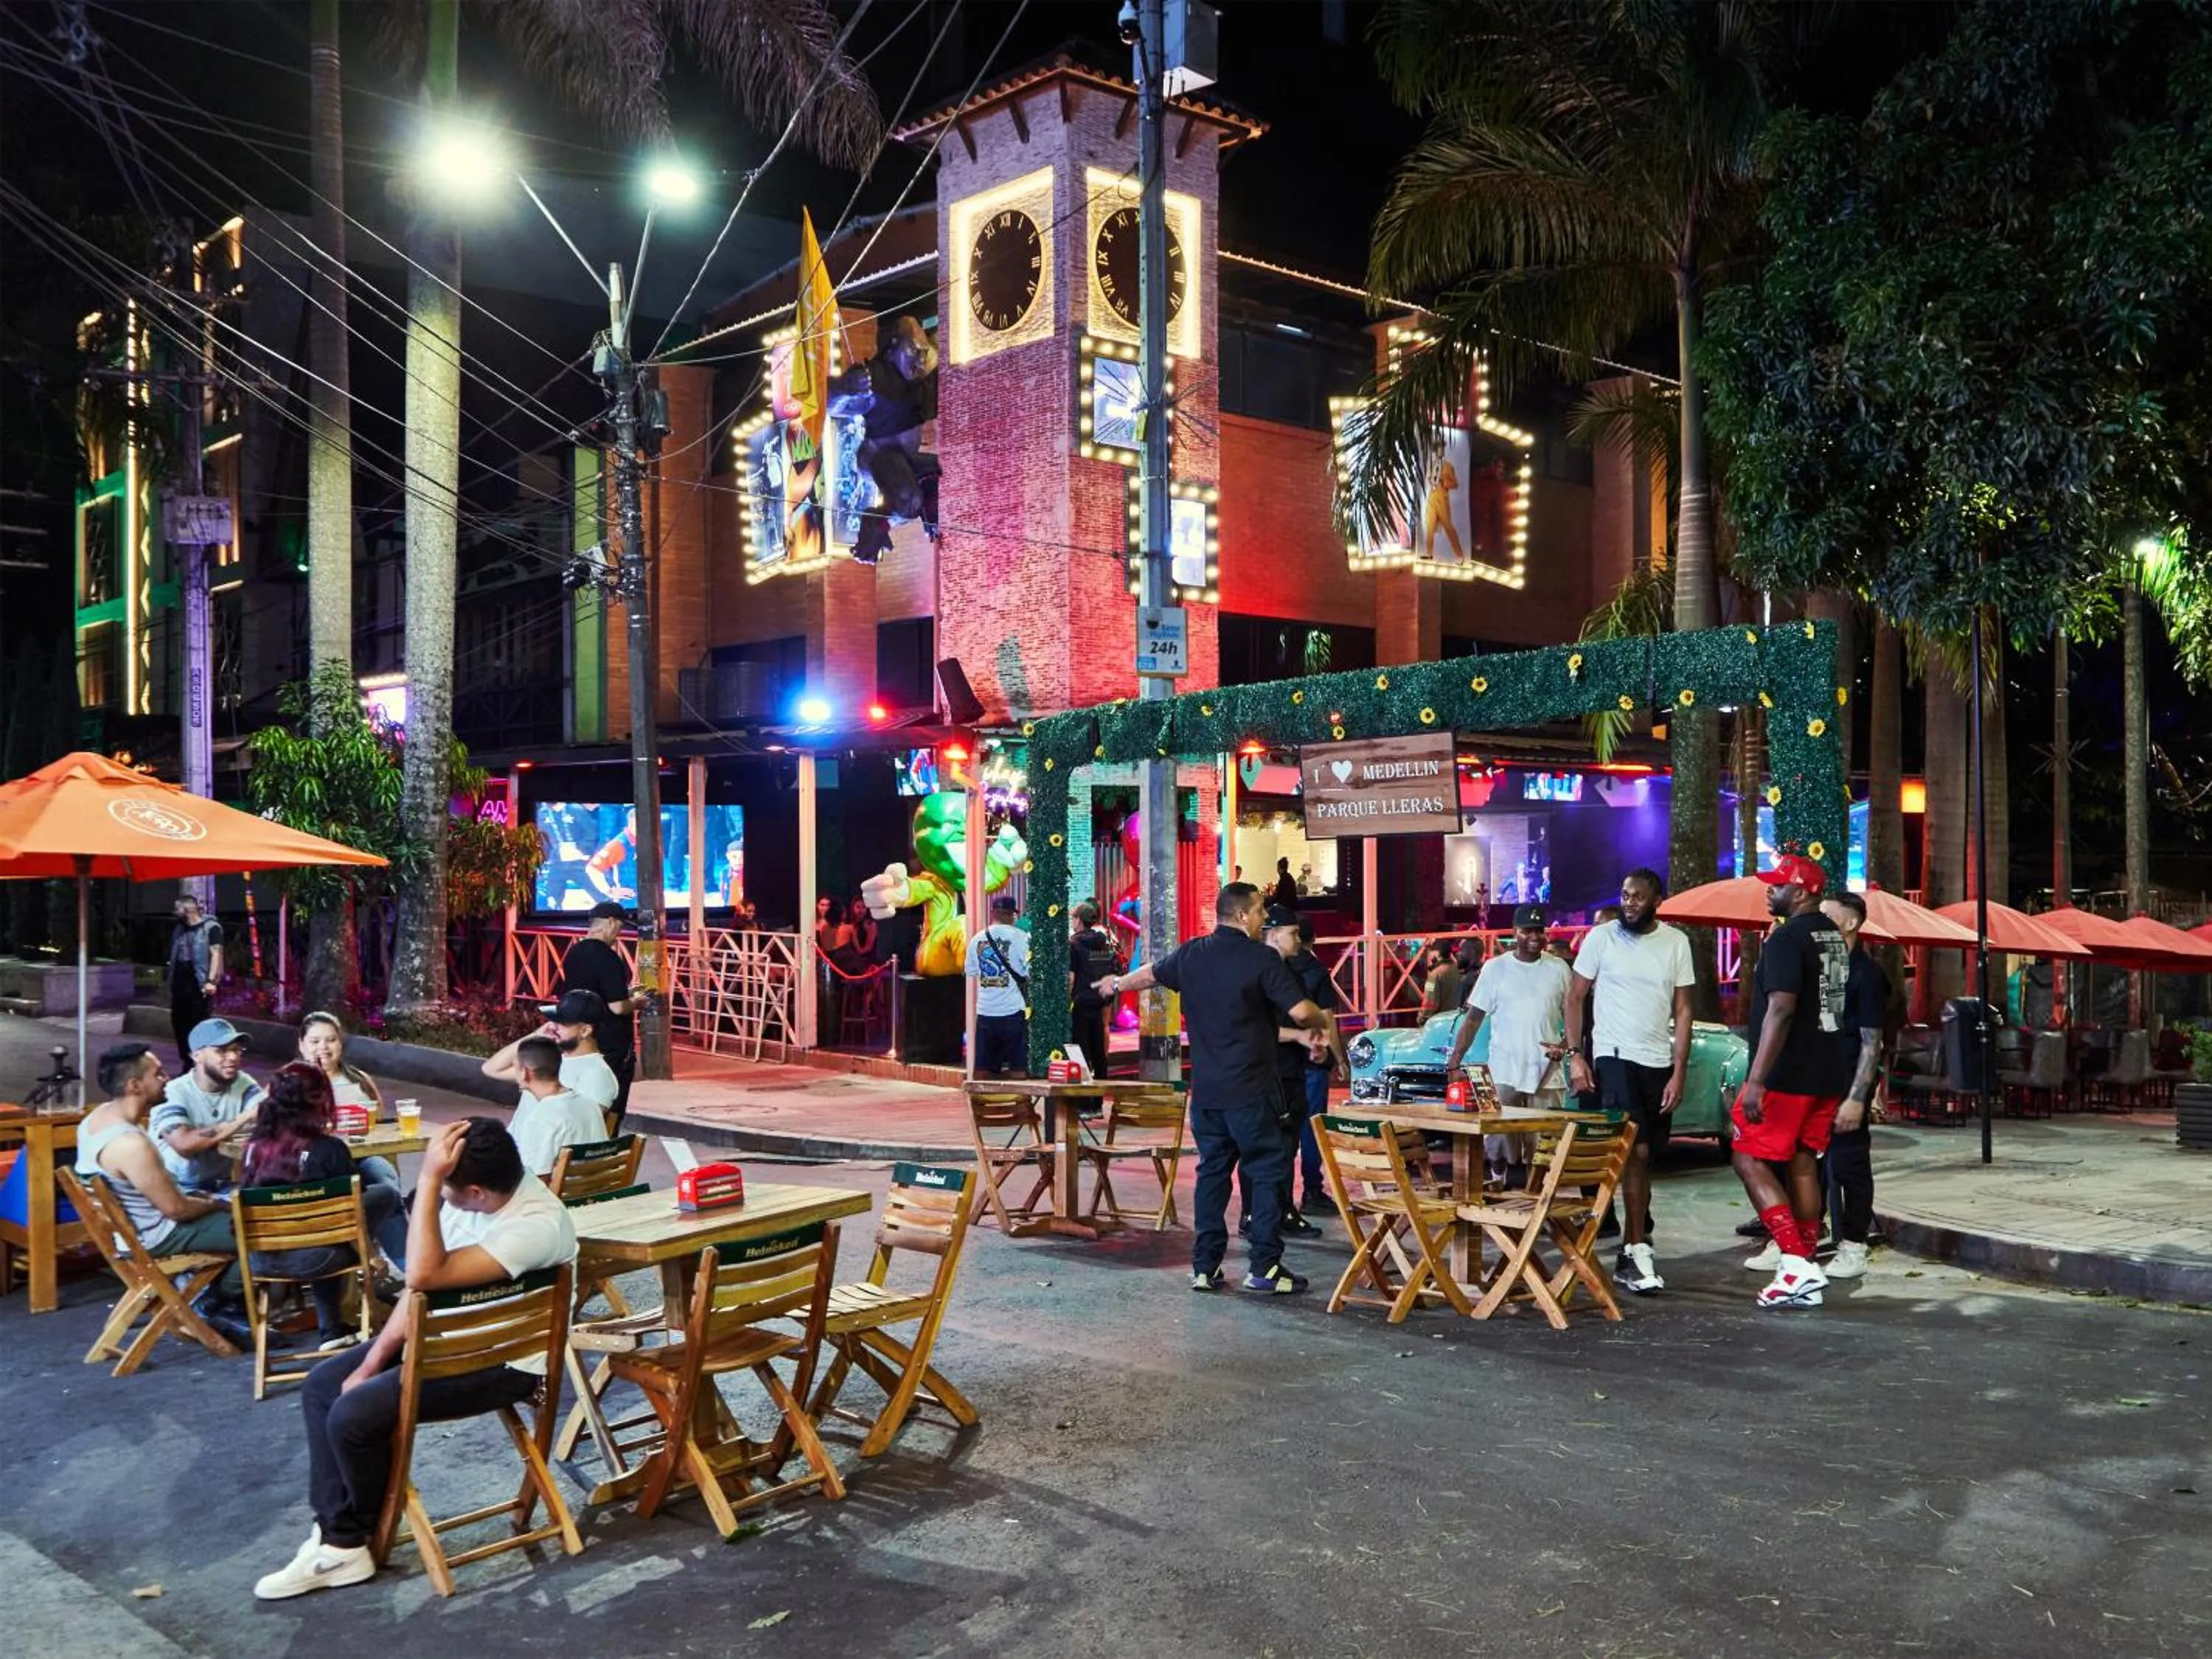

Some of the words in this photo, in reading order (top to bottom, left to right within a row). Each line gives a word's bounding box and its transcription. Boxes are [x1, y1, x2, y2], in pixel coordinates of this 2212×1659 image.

[1102, 229, 1114, 243] X
[974, 247, 983, 260] X
[1097, 249, 1109, 266] IX
[1150, 641, 1178, 655] 24h
[1314, 768, 1320, 784] I
[1363, 760, 1439, 780] MEDELLIN
[1317, 801, 1378, 818] PARQUE
[1382, 796, 1444, 815] LLERAS
